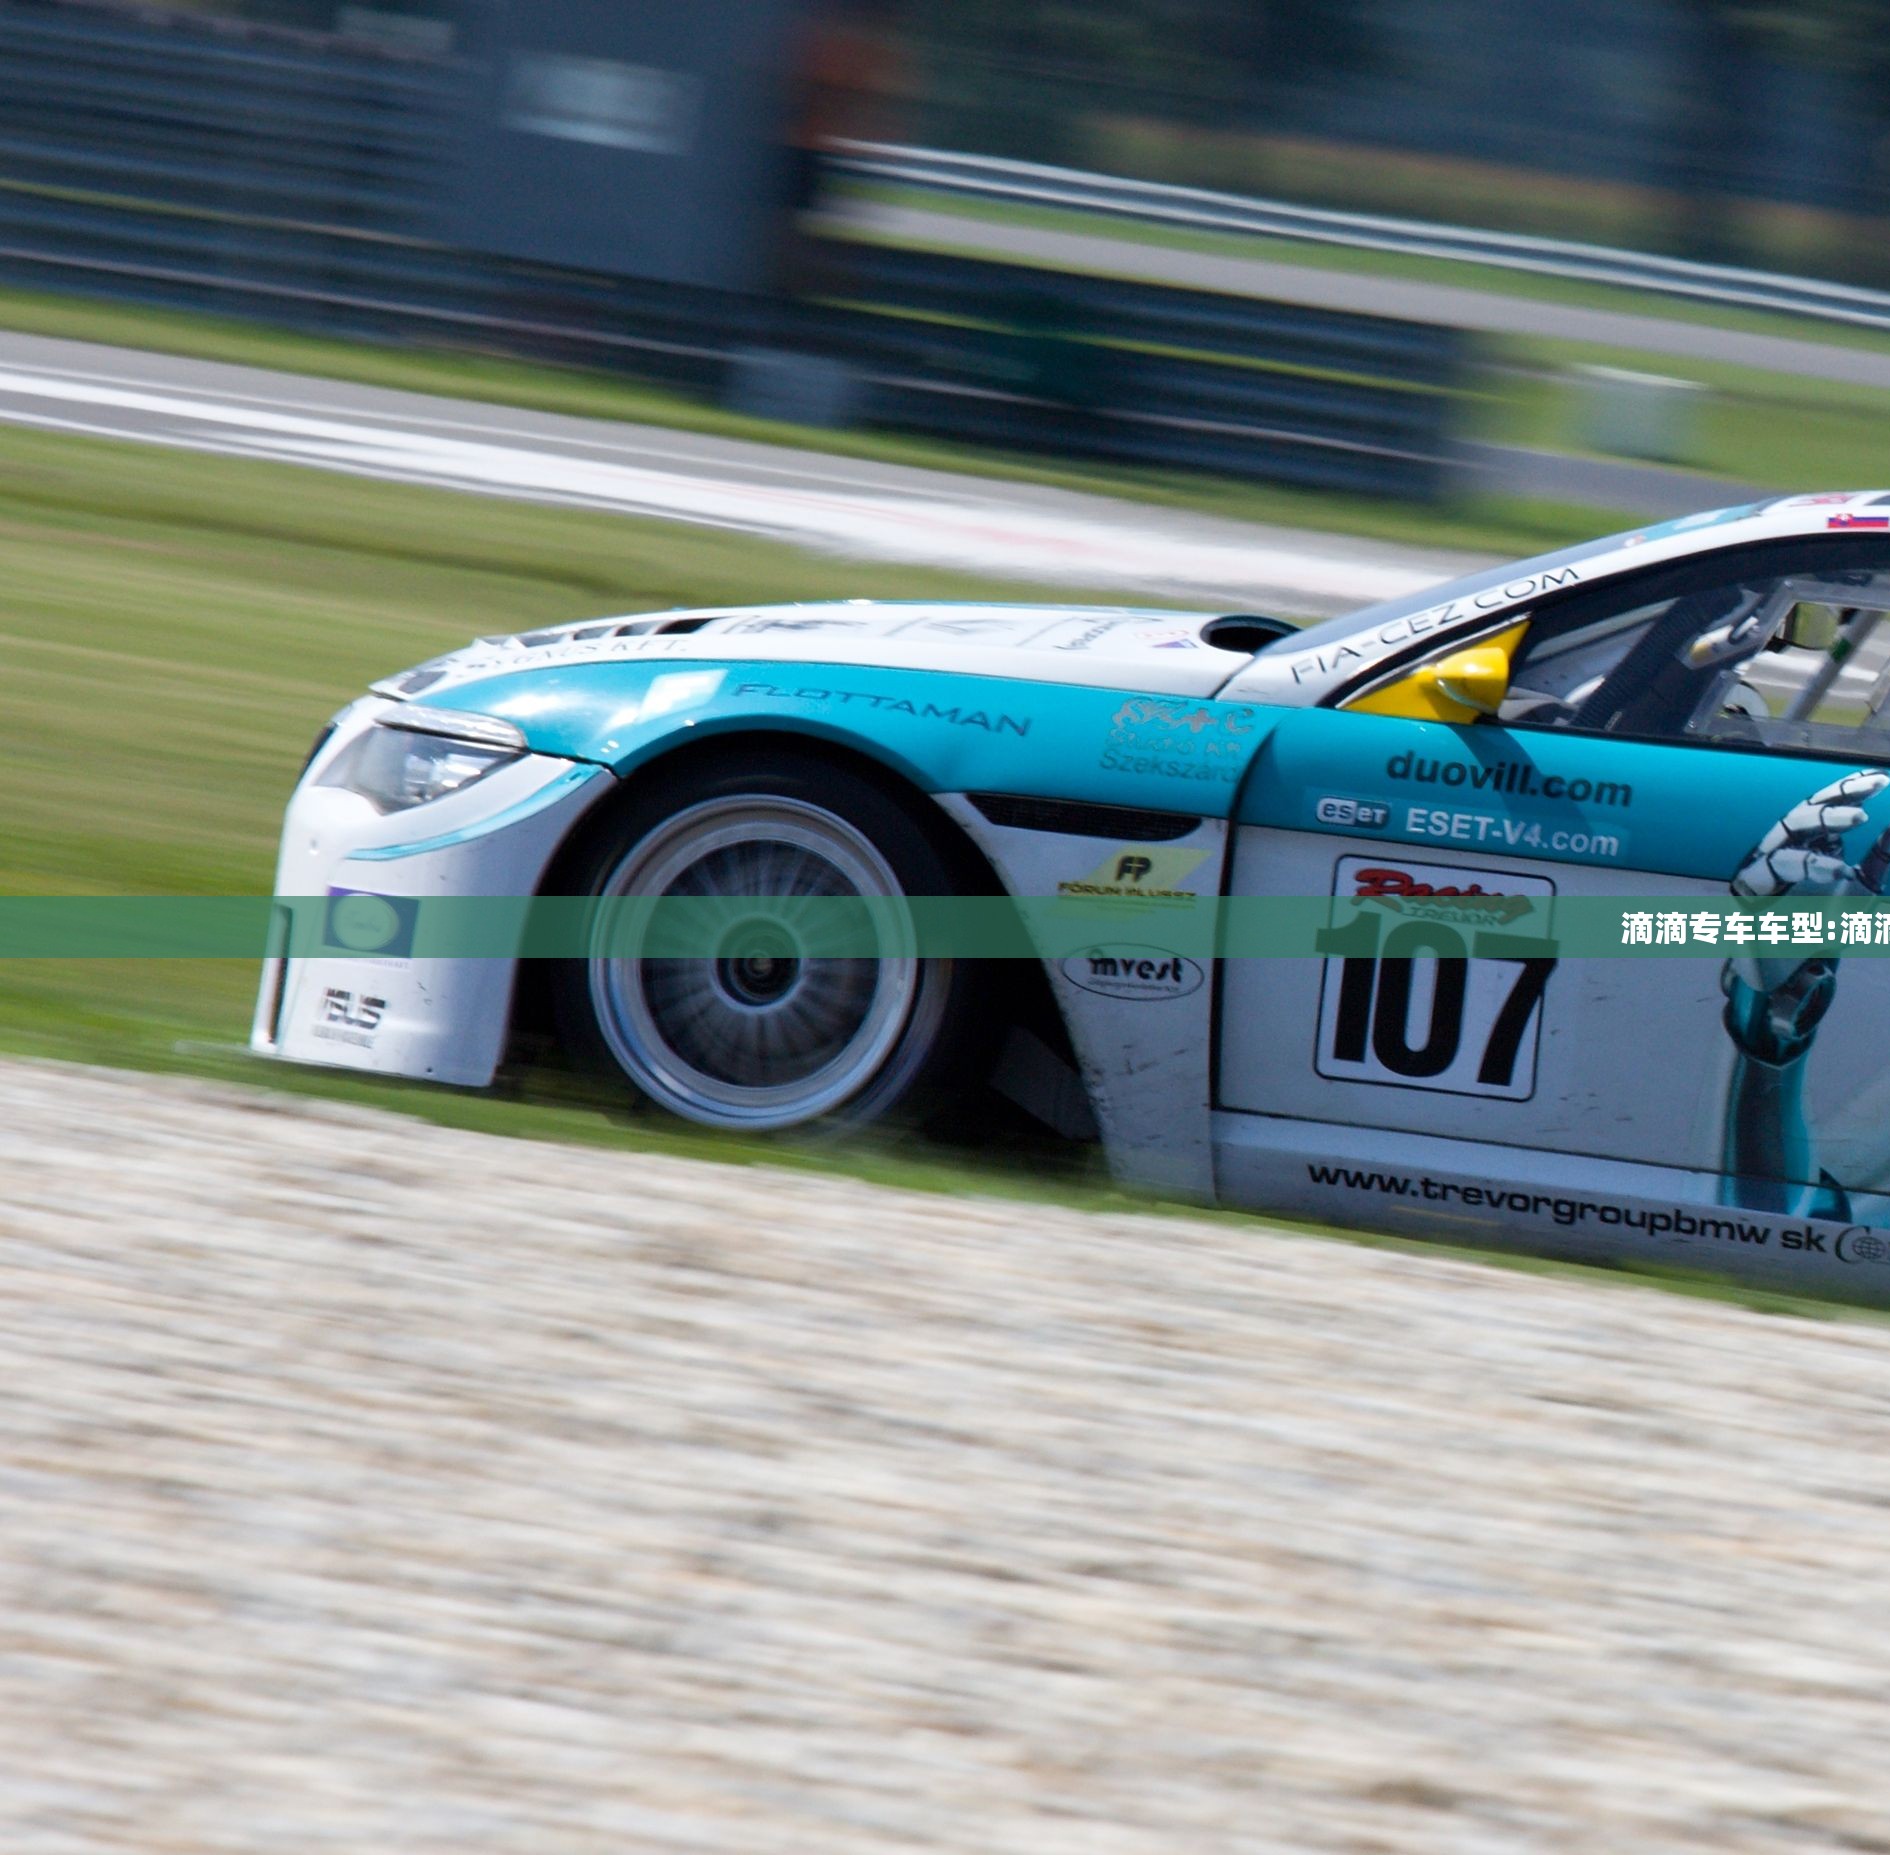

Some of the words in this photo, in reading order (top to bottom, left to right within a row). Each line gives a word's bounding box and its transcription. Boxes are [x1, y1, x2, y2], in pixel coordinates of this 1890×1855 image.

[1385, 749, 1633, 808] duovill.com
[1405, 806, 1620, 857] ESET-V4.com
[1314, 910, 1560, 1087] 107
